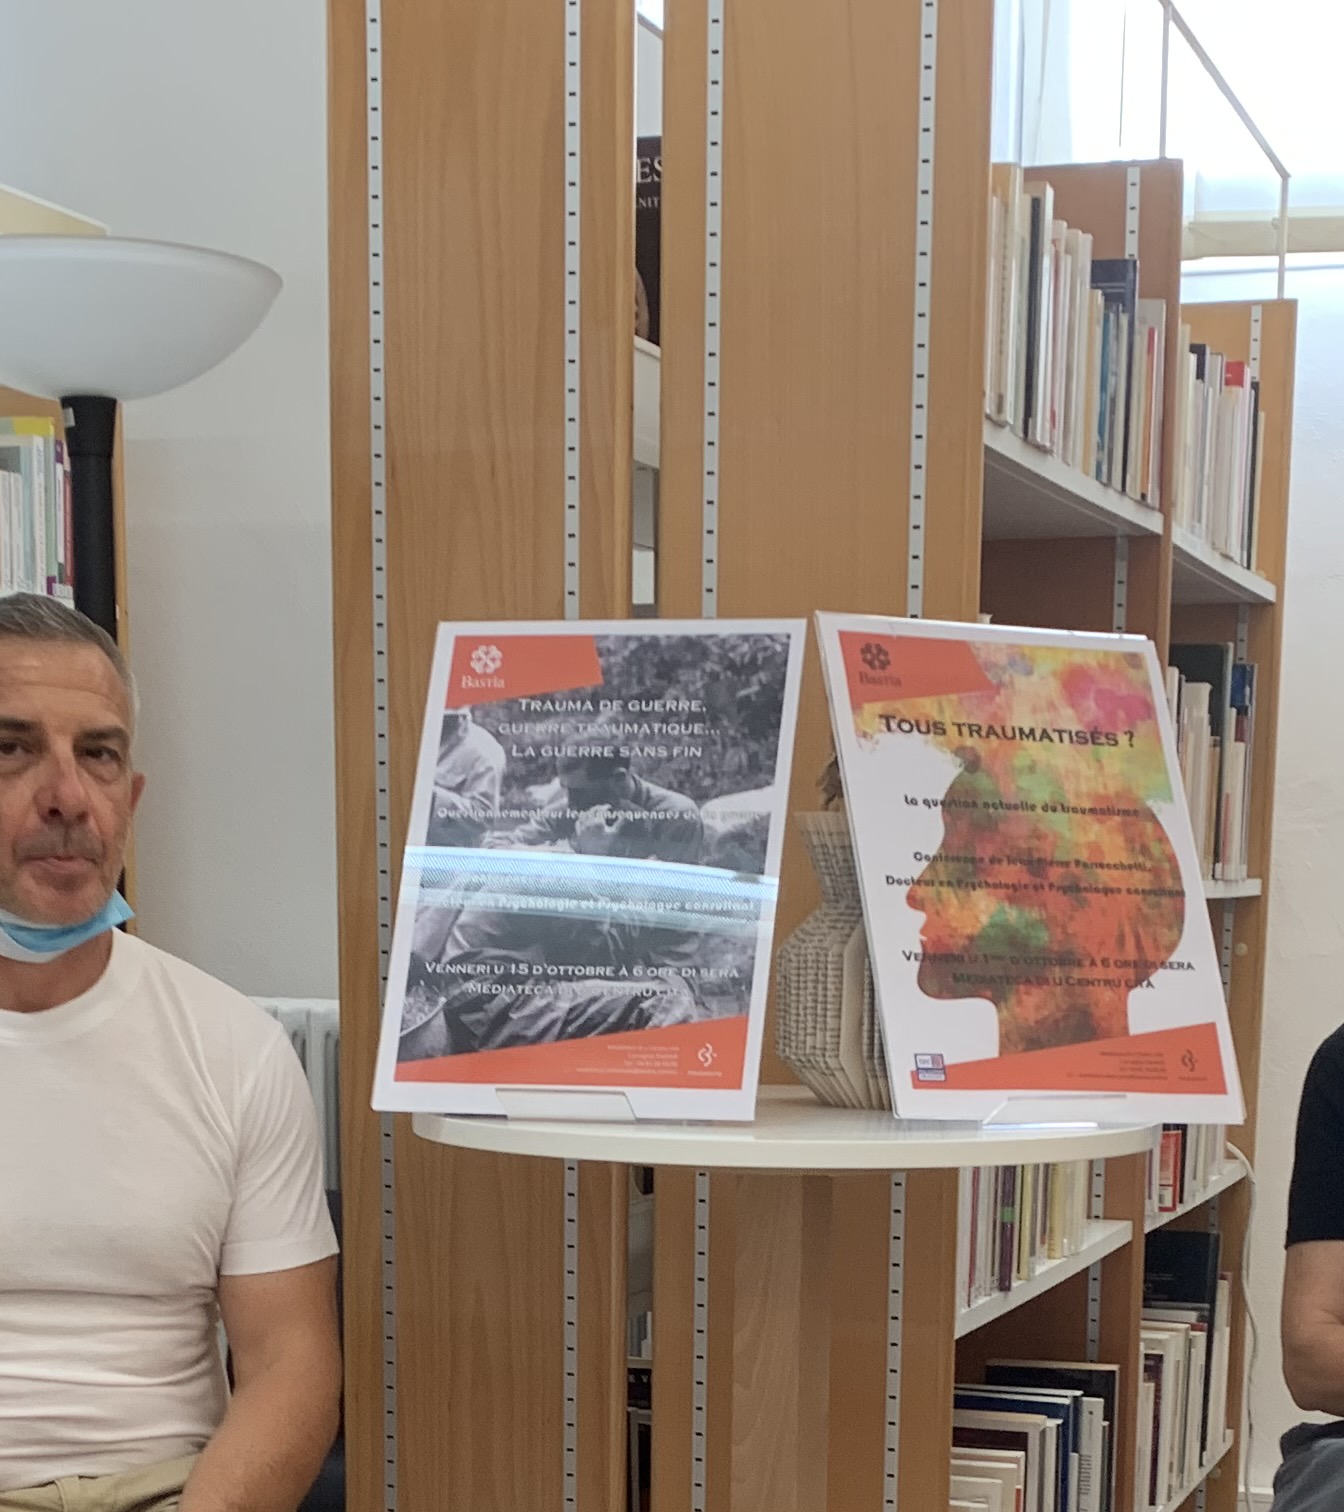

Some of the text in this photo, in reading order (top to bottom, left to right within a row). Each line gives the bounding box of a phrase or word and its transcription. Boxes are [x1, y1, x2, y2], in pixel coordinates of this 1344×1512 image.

[519, 698, 592, 713] TRAUMA
[599, 699, 624, 713] DE
[878, 713, 947, 737] TOUS
[952, 720, 1119, 748] TRAUMATISÉS
[511, 744, 702, 759] LA GUERRE SANS FIN
[425, 961, 493, 976] VENNERI
[494, 963, 505, 976] U
[510, 962, 529, 976] 15
[532, 962, 616, 978] D'OTTOBRE
[632, 965, 643, 978] 6
